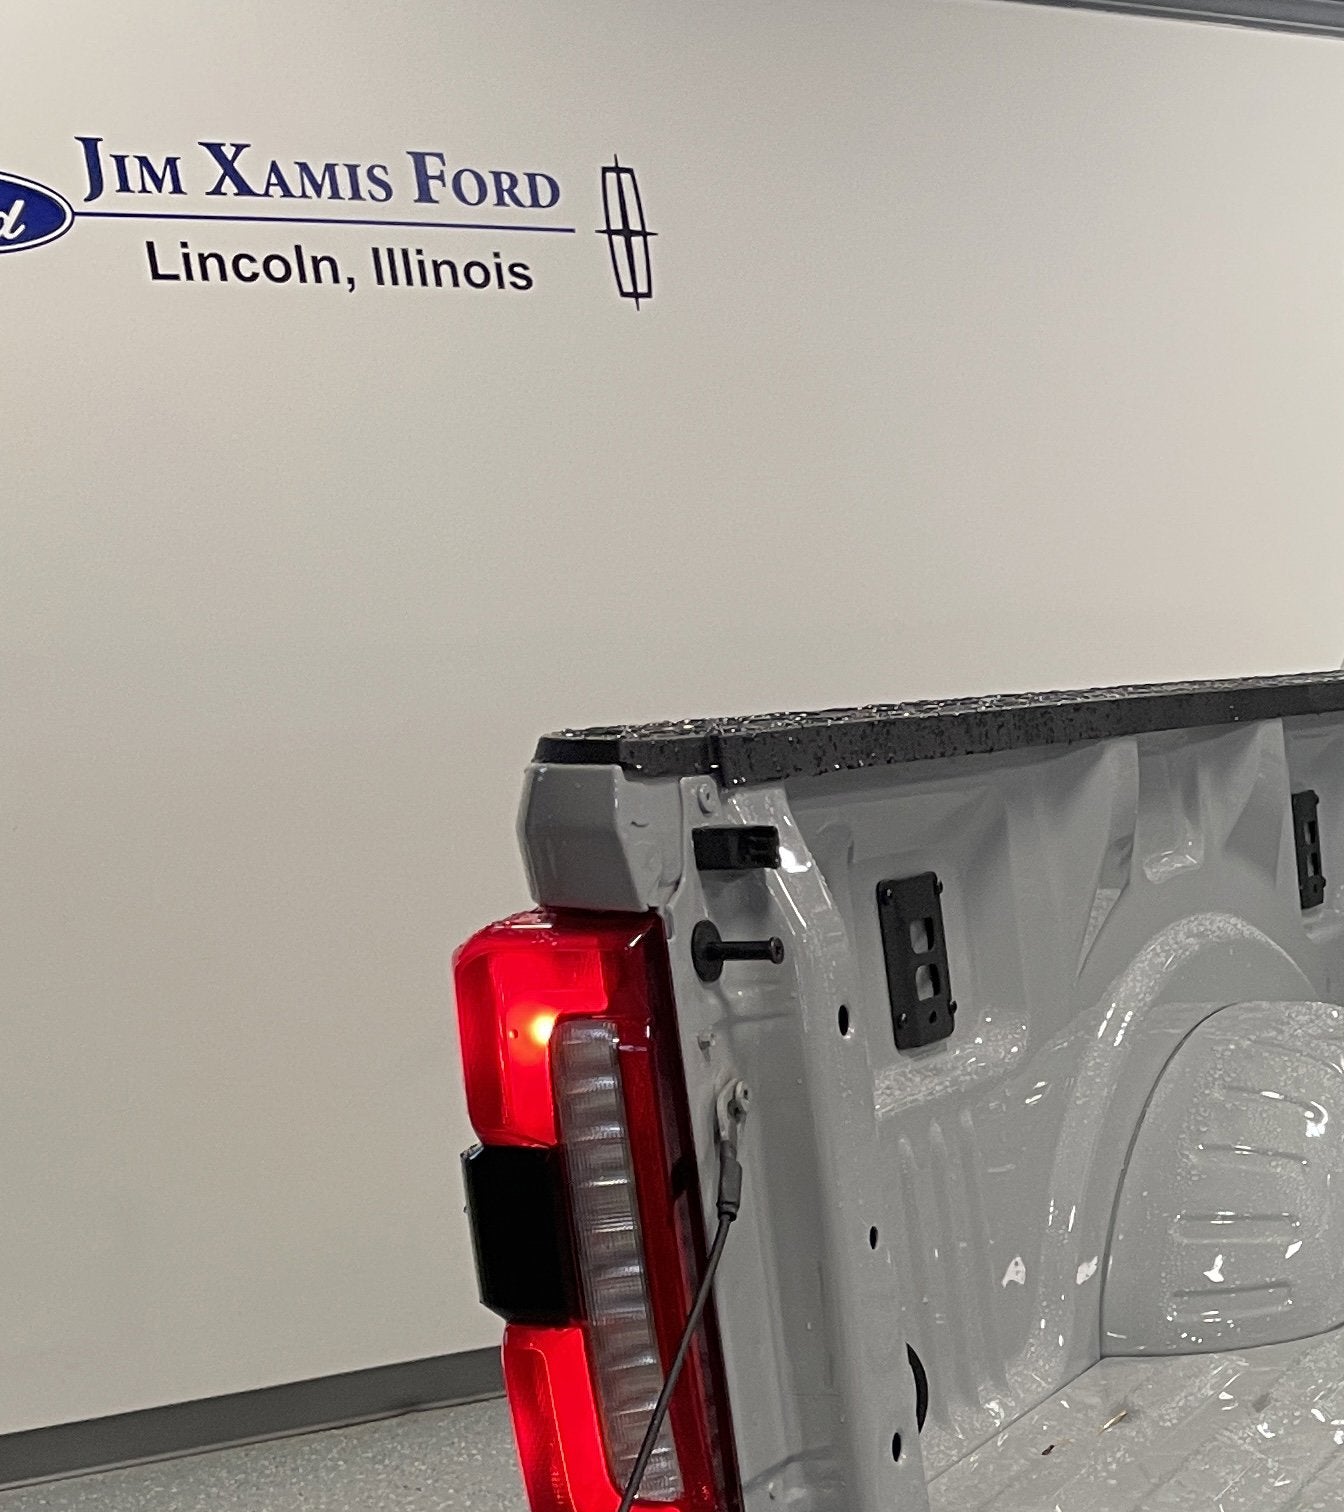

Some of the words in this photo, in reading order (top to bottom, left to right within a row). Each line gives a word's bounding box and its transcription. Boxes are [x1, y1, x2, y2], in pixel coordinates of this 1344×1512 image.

[74, 136, 187, 203] JIM
[197, 141, 394, 203] XAMIS
[405, 150, 561, 209] FORD
[145, 240, 356, 293] Lincoln,
[371, 246, 534, 291] Illinois
